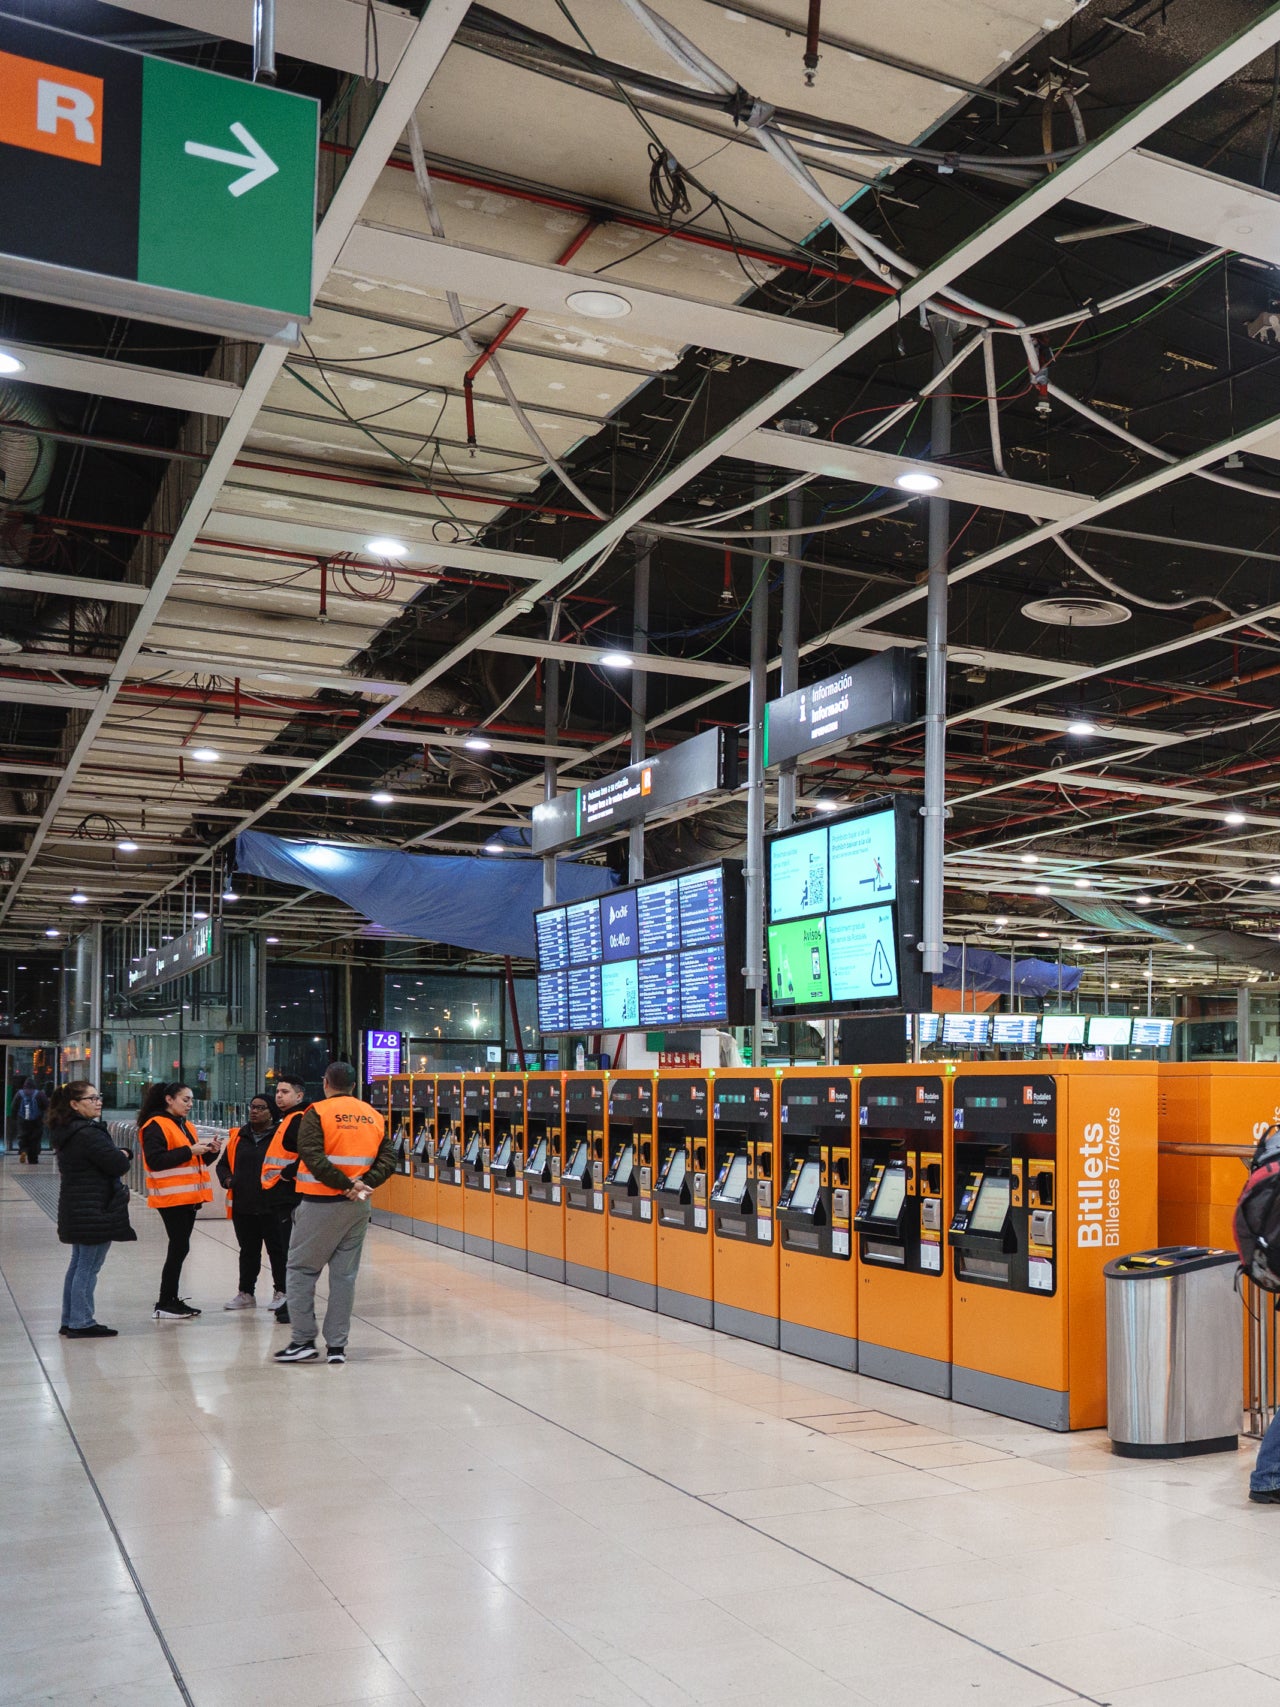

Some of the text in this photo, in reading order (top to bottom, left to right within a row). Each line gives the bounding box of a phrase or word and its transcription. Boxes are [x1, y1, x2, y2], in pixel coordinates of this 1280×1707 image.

[37, 78, 95, 144] R
[812, 674, 853, 703] Información
[811, 694, 849, 723] Informació
[615, 905, 628, 919] adif
[804, 928, 822, 942] Avisos
[335, 1114, 374, 1124] serveo
[1033, 1116, 1047, 1127] renfe
[1078, 1122, 1104, 1248] Bitllets
[1106, 1107, 1120, 1246] Billetes Tickets
